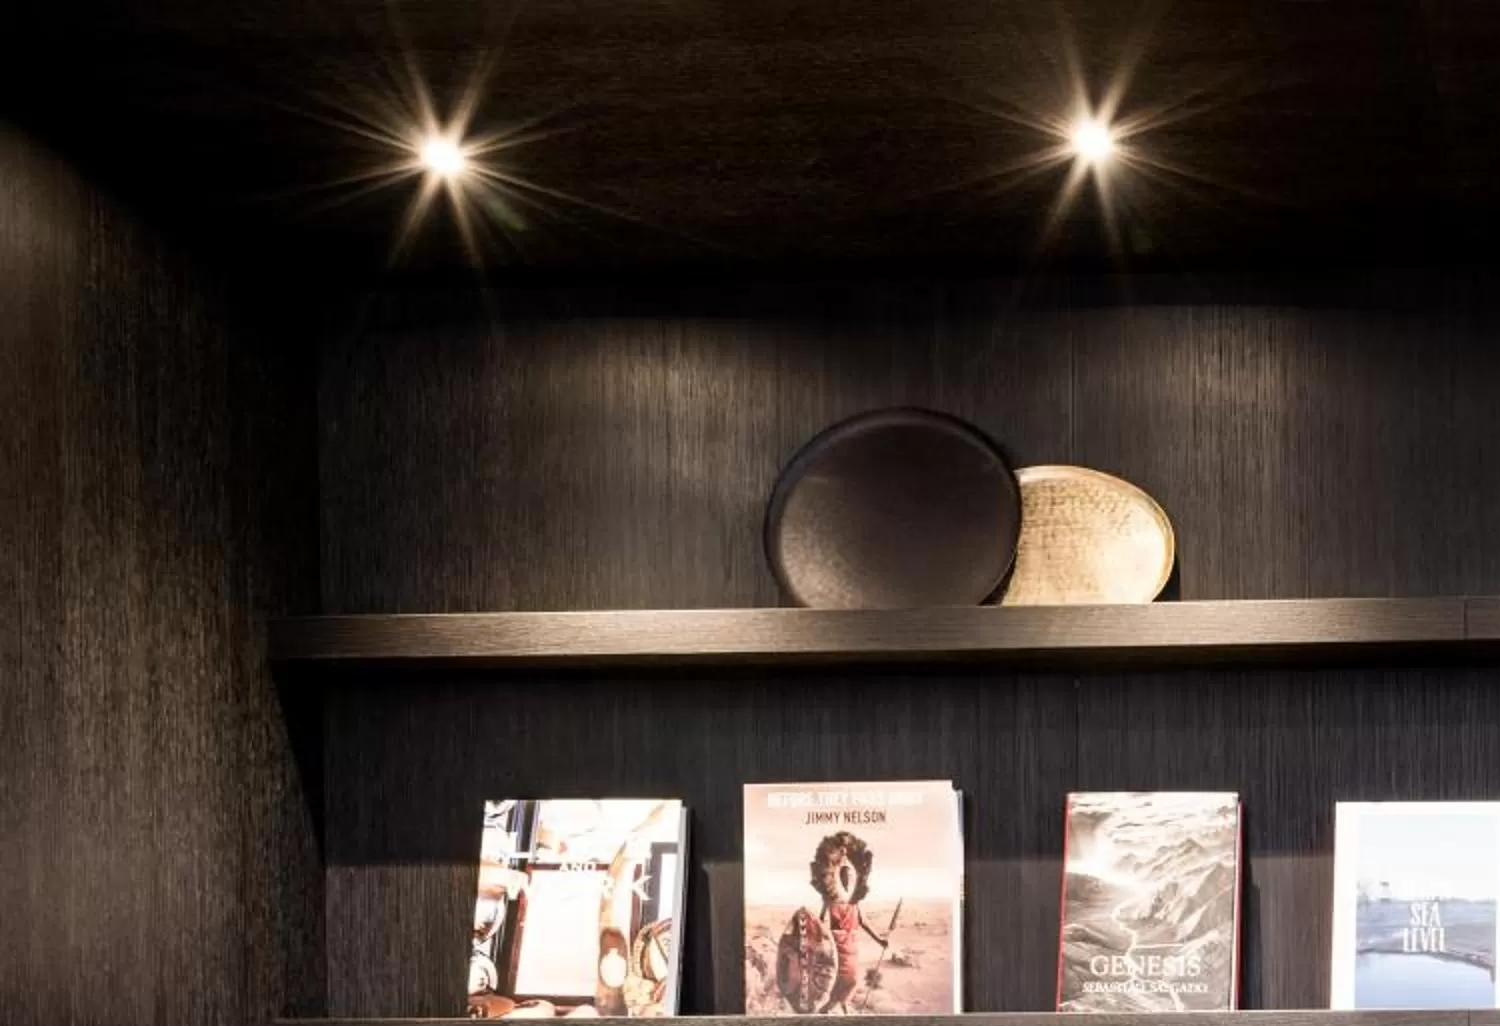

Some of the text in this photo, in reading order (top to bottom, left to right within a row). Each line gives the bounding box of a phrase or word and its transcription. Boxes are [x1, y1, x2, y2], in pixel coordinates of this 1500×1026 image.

[804, 809, 887, 825] JIMMY NELSON
[1410, 901, 1441, 927] SEA
[1090, 955, 1201, 977] GENESIS
